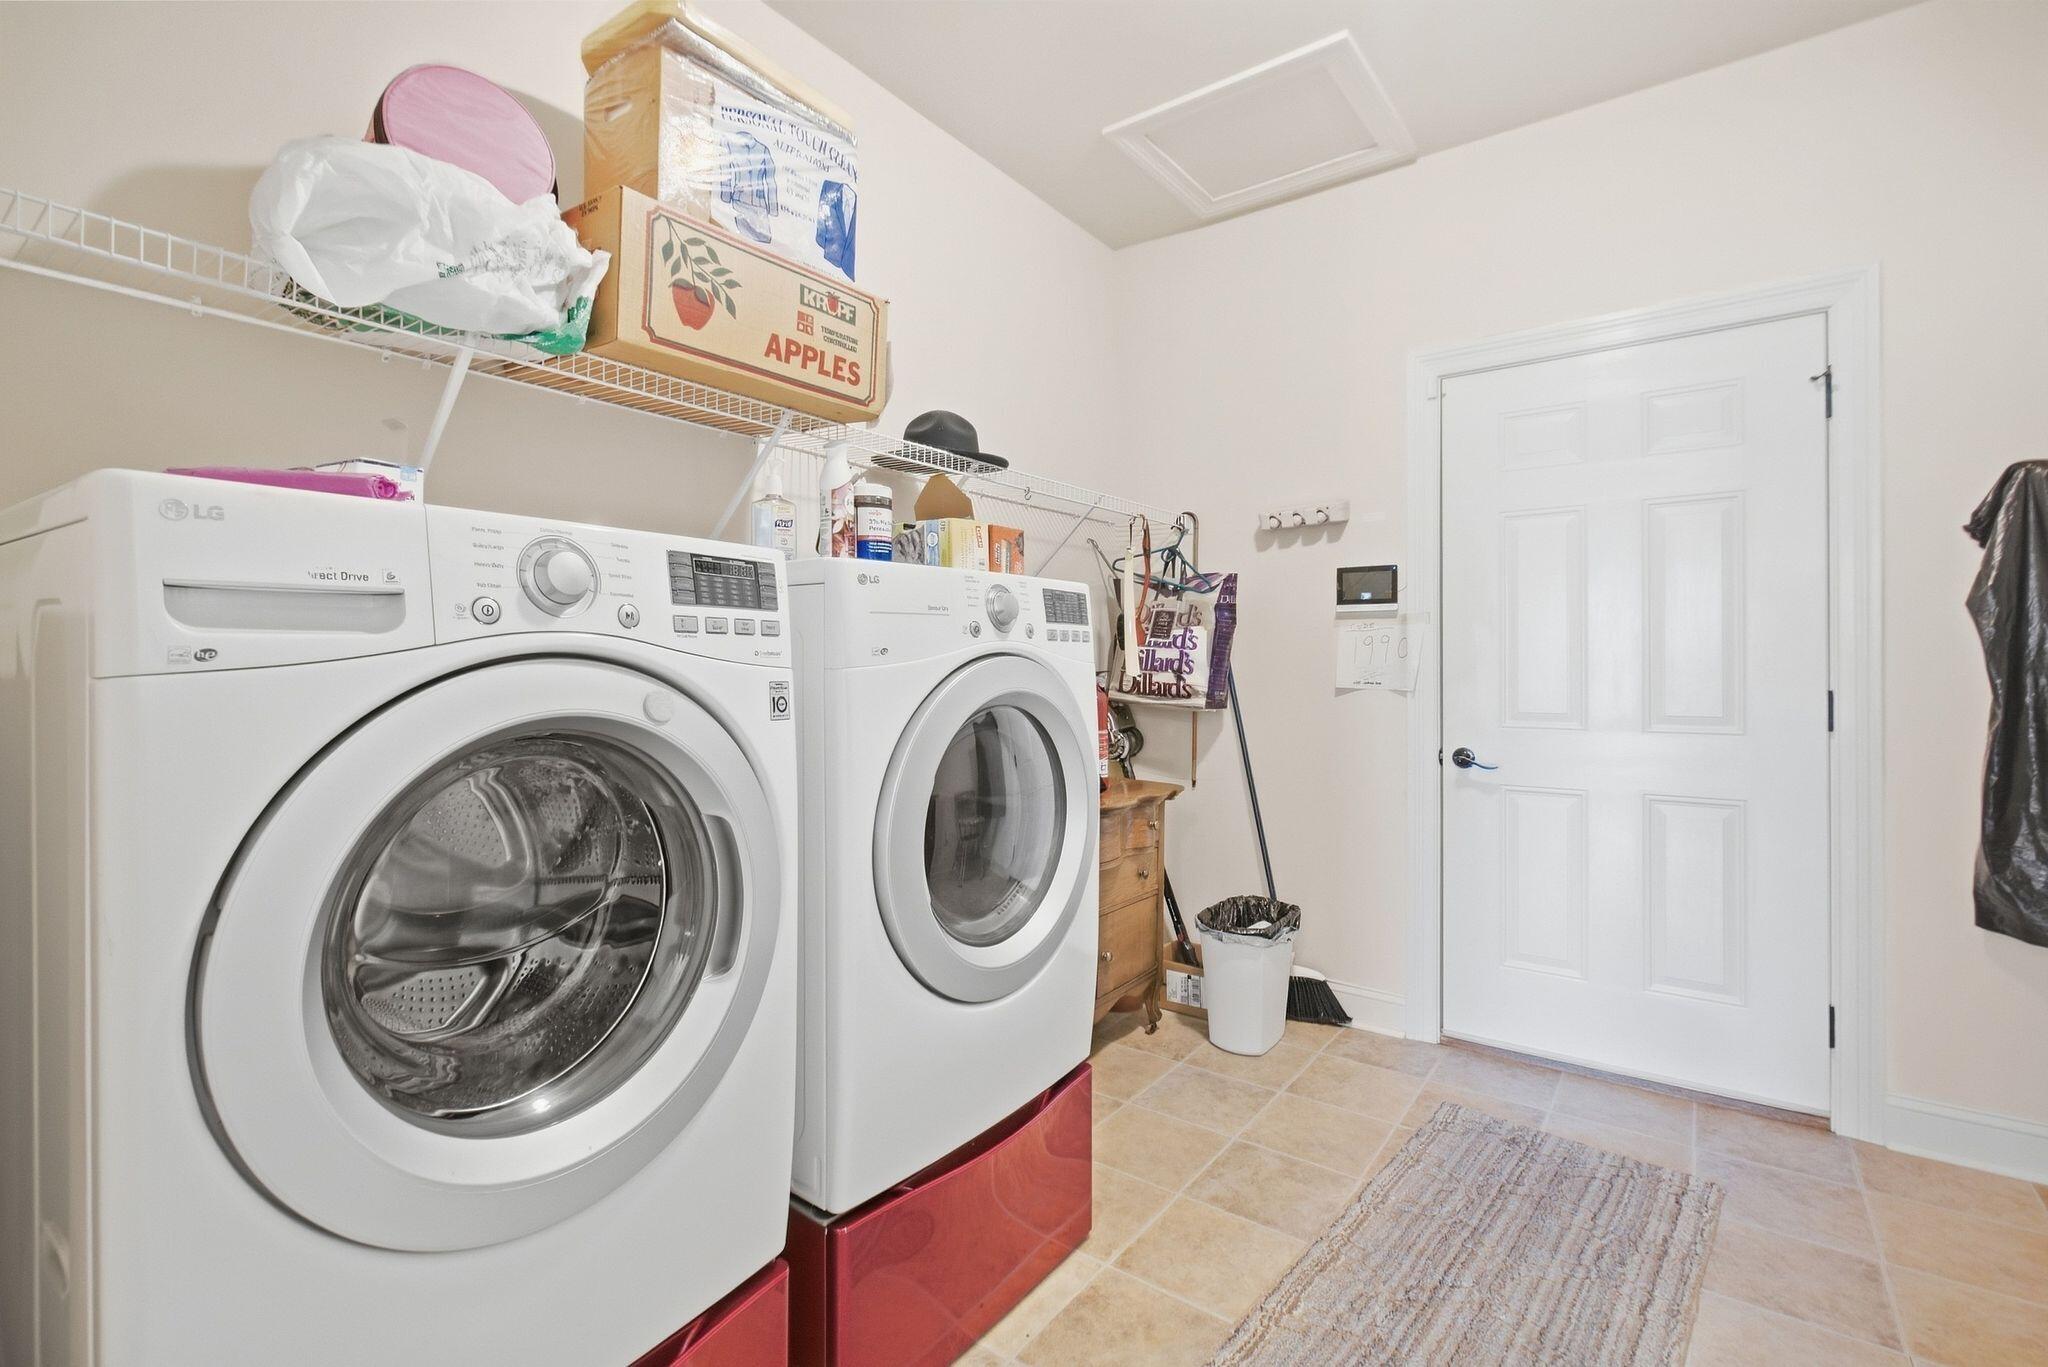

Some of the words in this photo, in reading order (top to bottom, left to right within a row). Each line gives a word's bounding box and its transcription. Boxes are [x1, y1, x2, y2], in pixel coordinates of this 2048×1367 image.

[764, 333, 861, 386] APPLES
[193, 504, 225, 521] LG
[340, 571, 369, 582] Drive
[868, 575, 880, 584] LG
[1353, 634, 1409, 665] 1990
